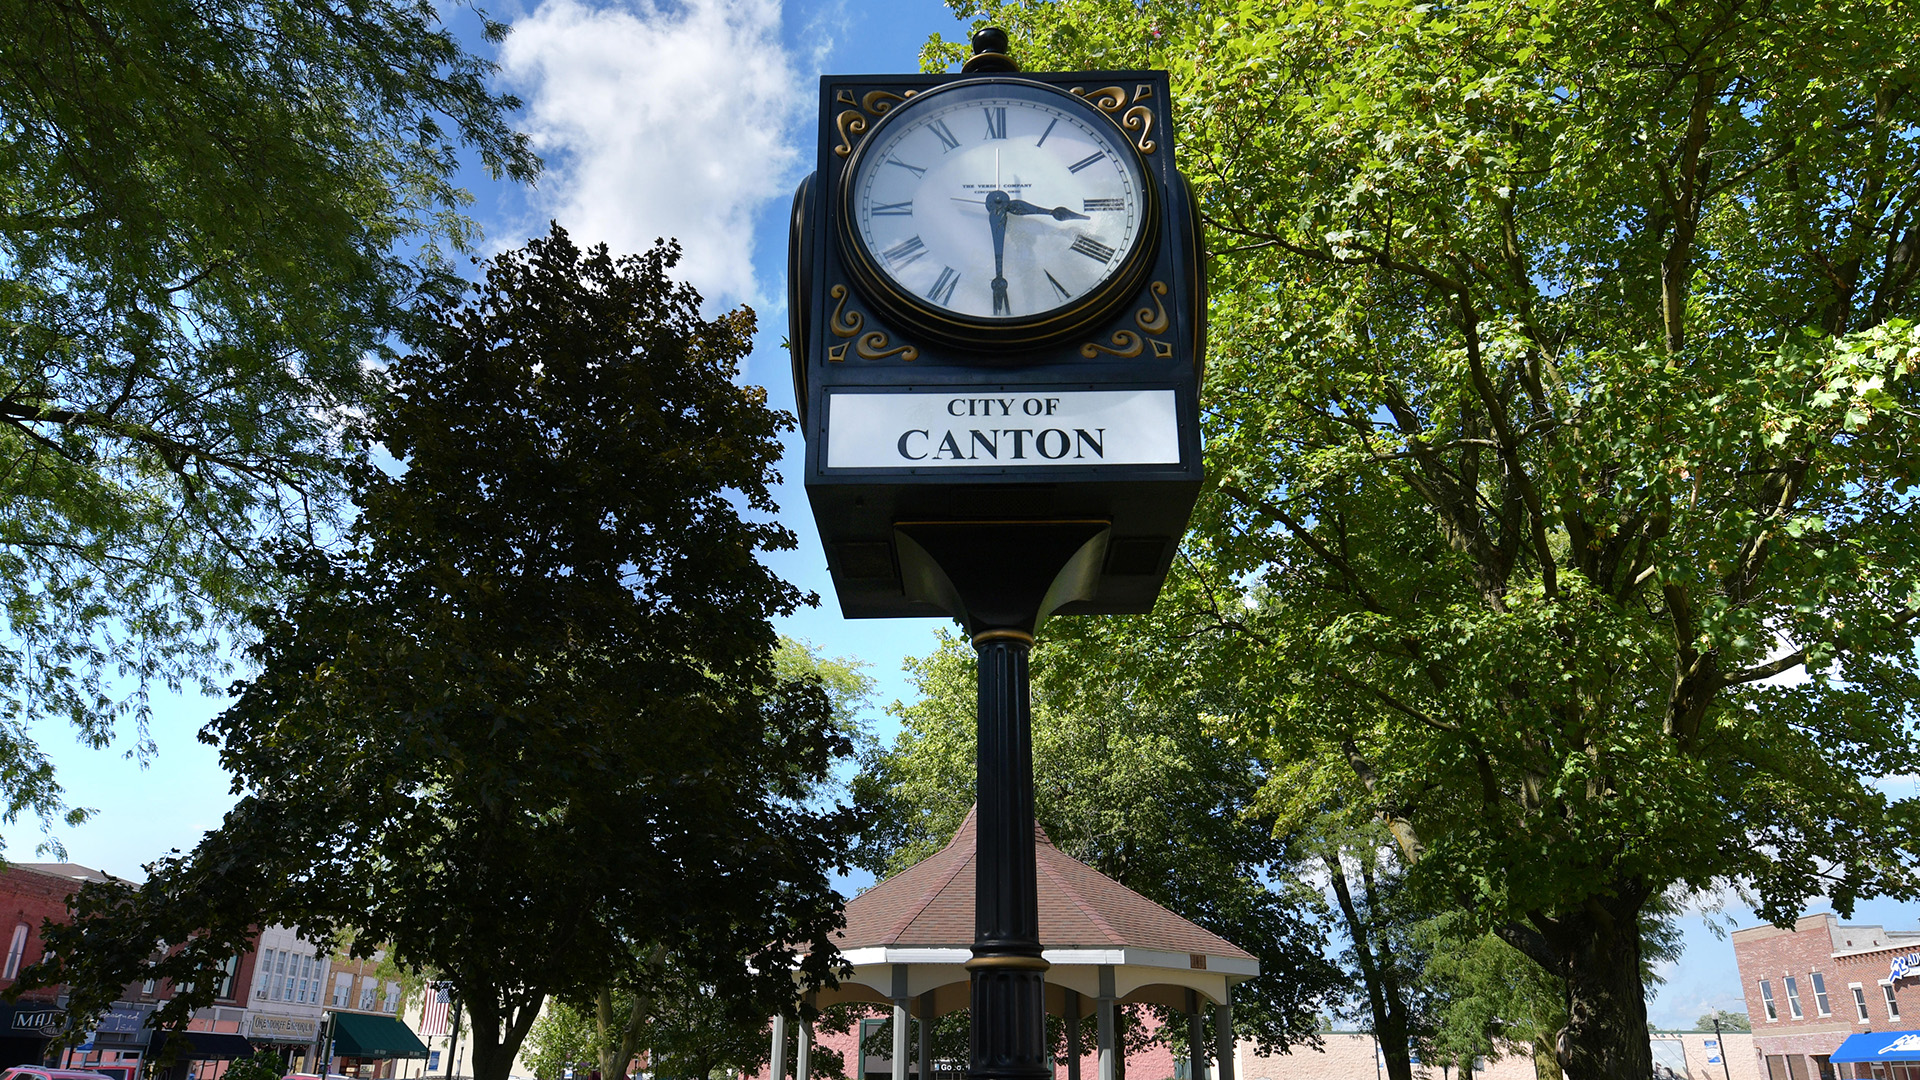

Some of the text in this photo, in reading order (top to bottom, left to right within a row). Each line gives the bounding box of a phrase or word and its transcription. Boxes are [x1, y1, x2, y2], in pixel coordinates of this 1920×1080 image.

[926, 118, 960, 154] XI
[984, 107, 1007, 139] XII
[1036, 117, 1058, 148] I
[885, 153, 928, 179] X
[1067, 150, 1107, 174] II
[871, 198, 913, 217] IX
[1083, 198, 1125, 212] III
[882, 233, 929, 272] VIII
[925, 265, 962, 306] VII
[1043, 268, 1073, 302] V
[947, 397, 1060, 417] CITY OF
[897, 428, 1106, 461] CANTON
[1907, 953, 1920, 966] AD
